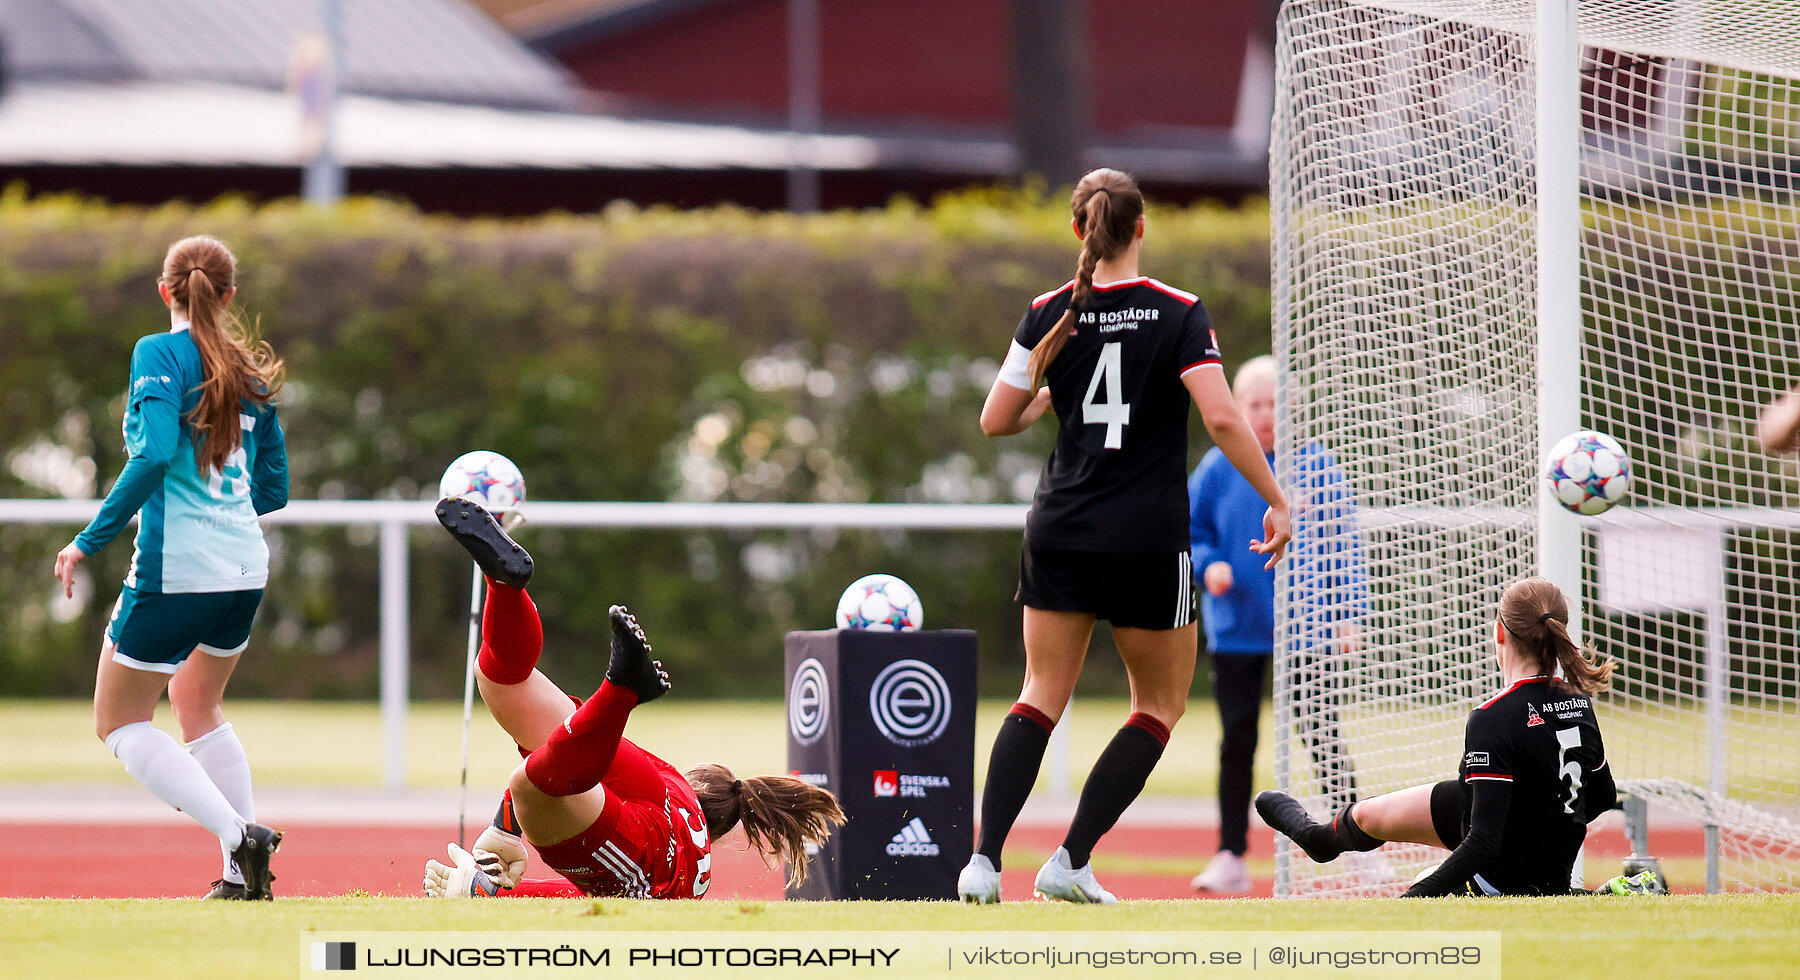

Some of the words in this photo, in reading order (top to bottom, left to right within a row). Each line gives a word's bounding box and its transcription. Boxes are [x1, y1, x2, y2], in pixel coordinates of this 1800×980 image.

[1079, 312, 1095, 324] AB
[1099, 307, 1159, 324] BOSTÄDER
[1099, 321, 1138, 333] LIDKÖPING
[1081, 341, 1130, 449] 4
[1543, 703, 1553, 713] AB
[1555, 726, 1583, 814] 5
[900, 774, 950, 787] SVENSKA
[900, 786, 926, 797] SPEL
[886, 842, 940, 856] adidas
